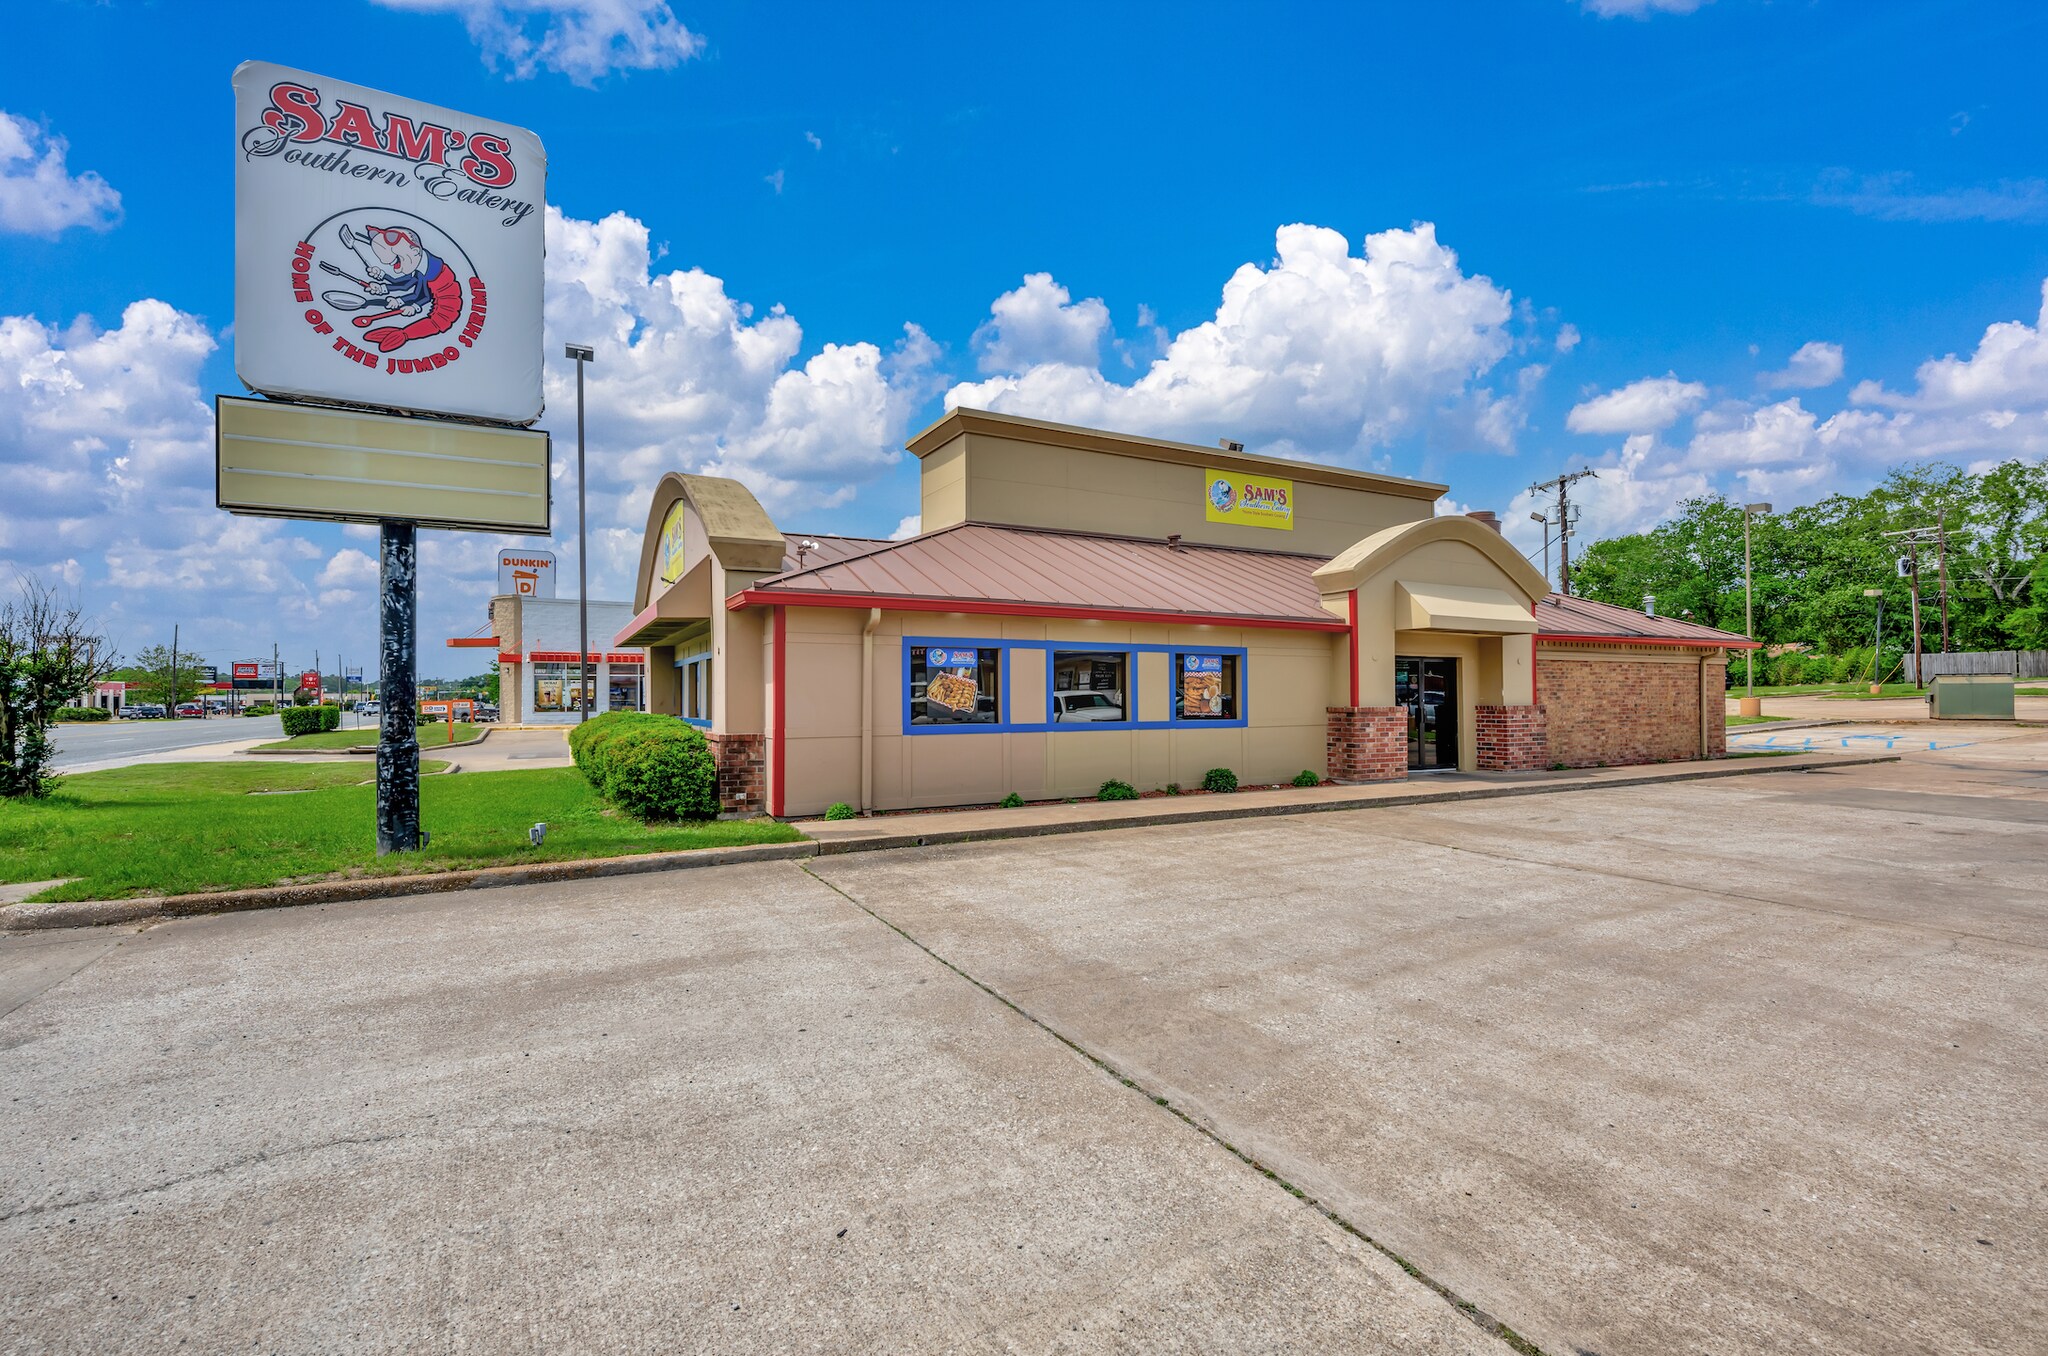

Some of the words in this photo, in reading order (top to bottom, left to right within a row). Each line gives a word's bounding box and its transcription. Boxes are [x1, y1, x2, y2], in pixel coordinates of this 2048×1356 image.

[261, 81, 516, 189] SAM'S
[241, 126, 410, 188] Southern
[414, 162, 535, 228] Eatery
[292, 241, 316, 303] HOME
[305, 309, 334, 335] OF
[332, 336, 379, 369] THE
[386, 346, 460, 375] JUMBO
[458, 276, 487, 348] SHRIMP
[1243, 484, 1287, 506] SAM'S
[503, 557, 552, 568] DUNKIN'
[520, 582, 532, 593] D
